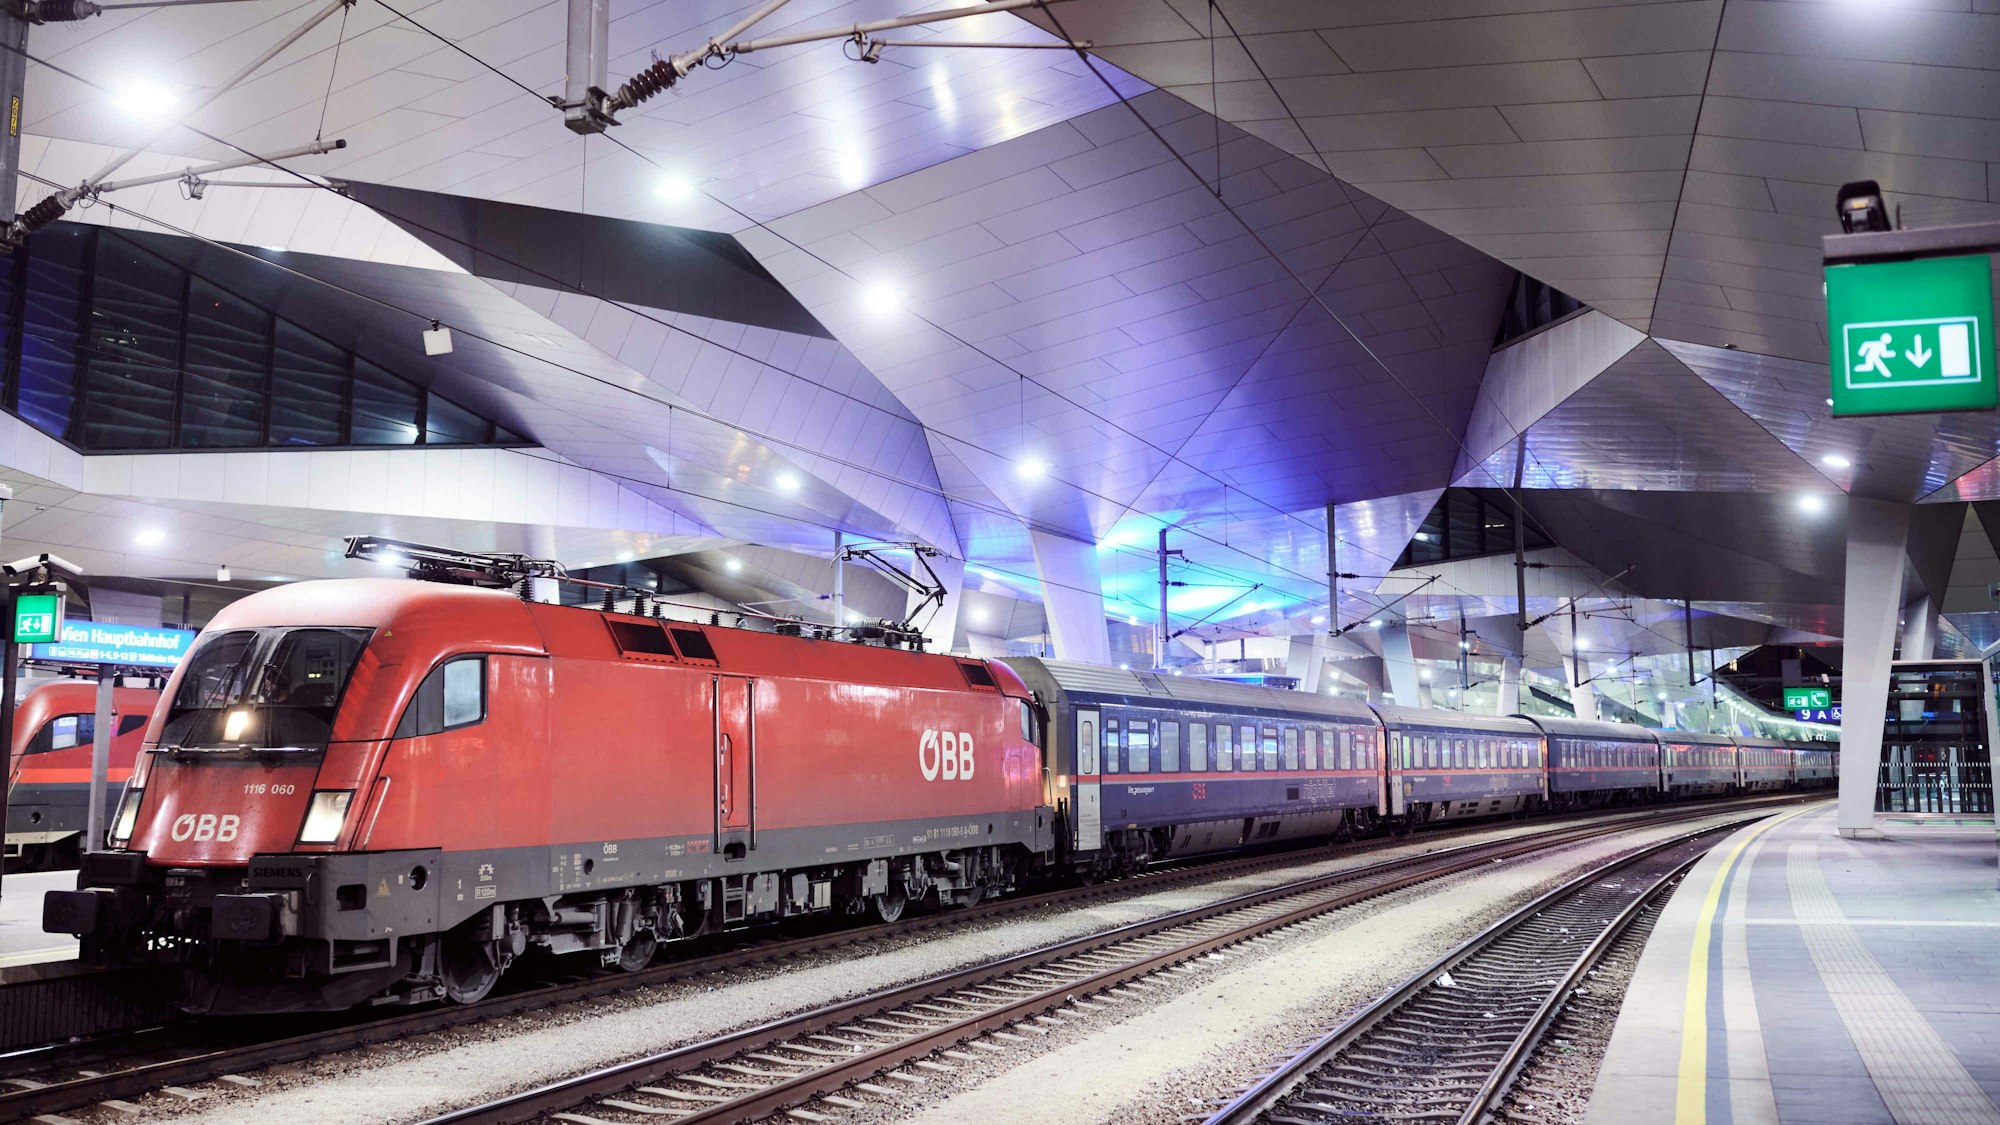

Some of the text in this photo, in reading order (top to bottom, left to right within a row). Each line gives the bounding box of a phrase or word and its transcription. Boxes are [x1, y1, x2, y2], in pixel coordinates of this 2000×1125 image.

[91, 628, 180, 649] Hauptbahnhof
[1801, 709, 1828, 720] 9 A
[918, 729, 975, 781] ÖBB
[243, 784, 295, 795] 1116 060
[171, 814, 240, 842] ÖBB
[603, 842, 618, 854] ÖBB
[253, 867, 302, 878] SIEMENS
[457, 879, 462, 889] 1
